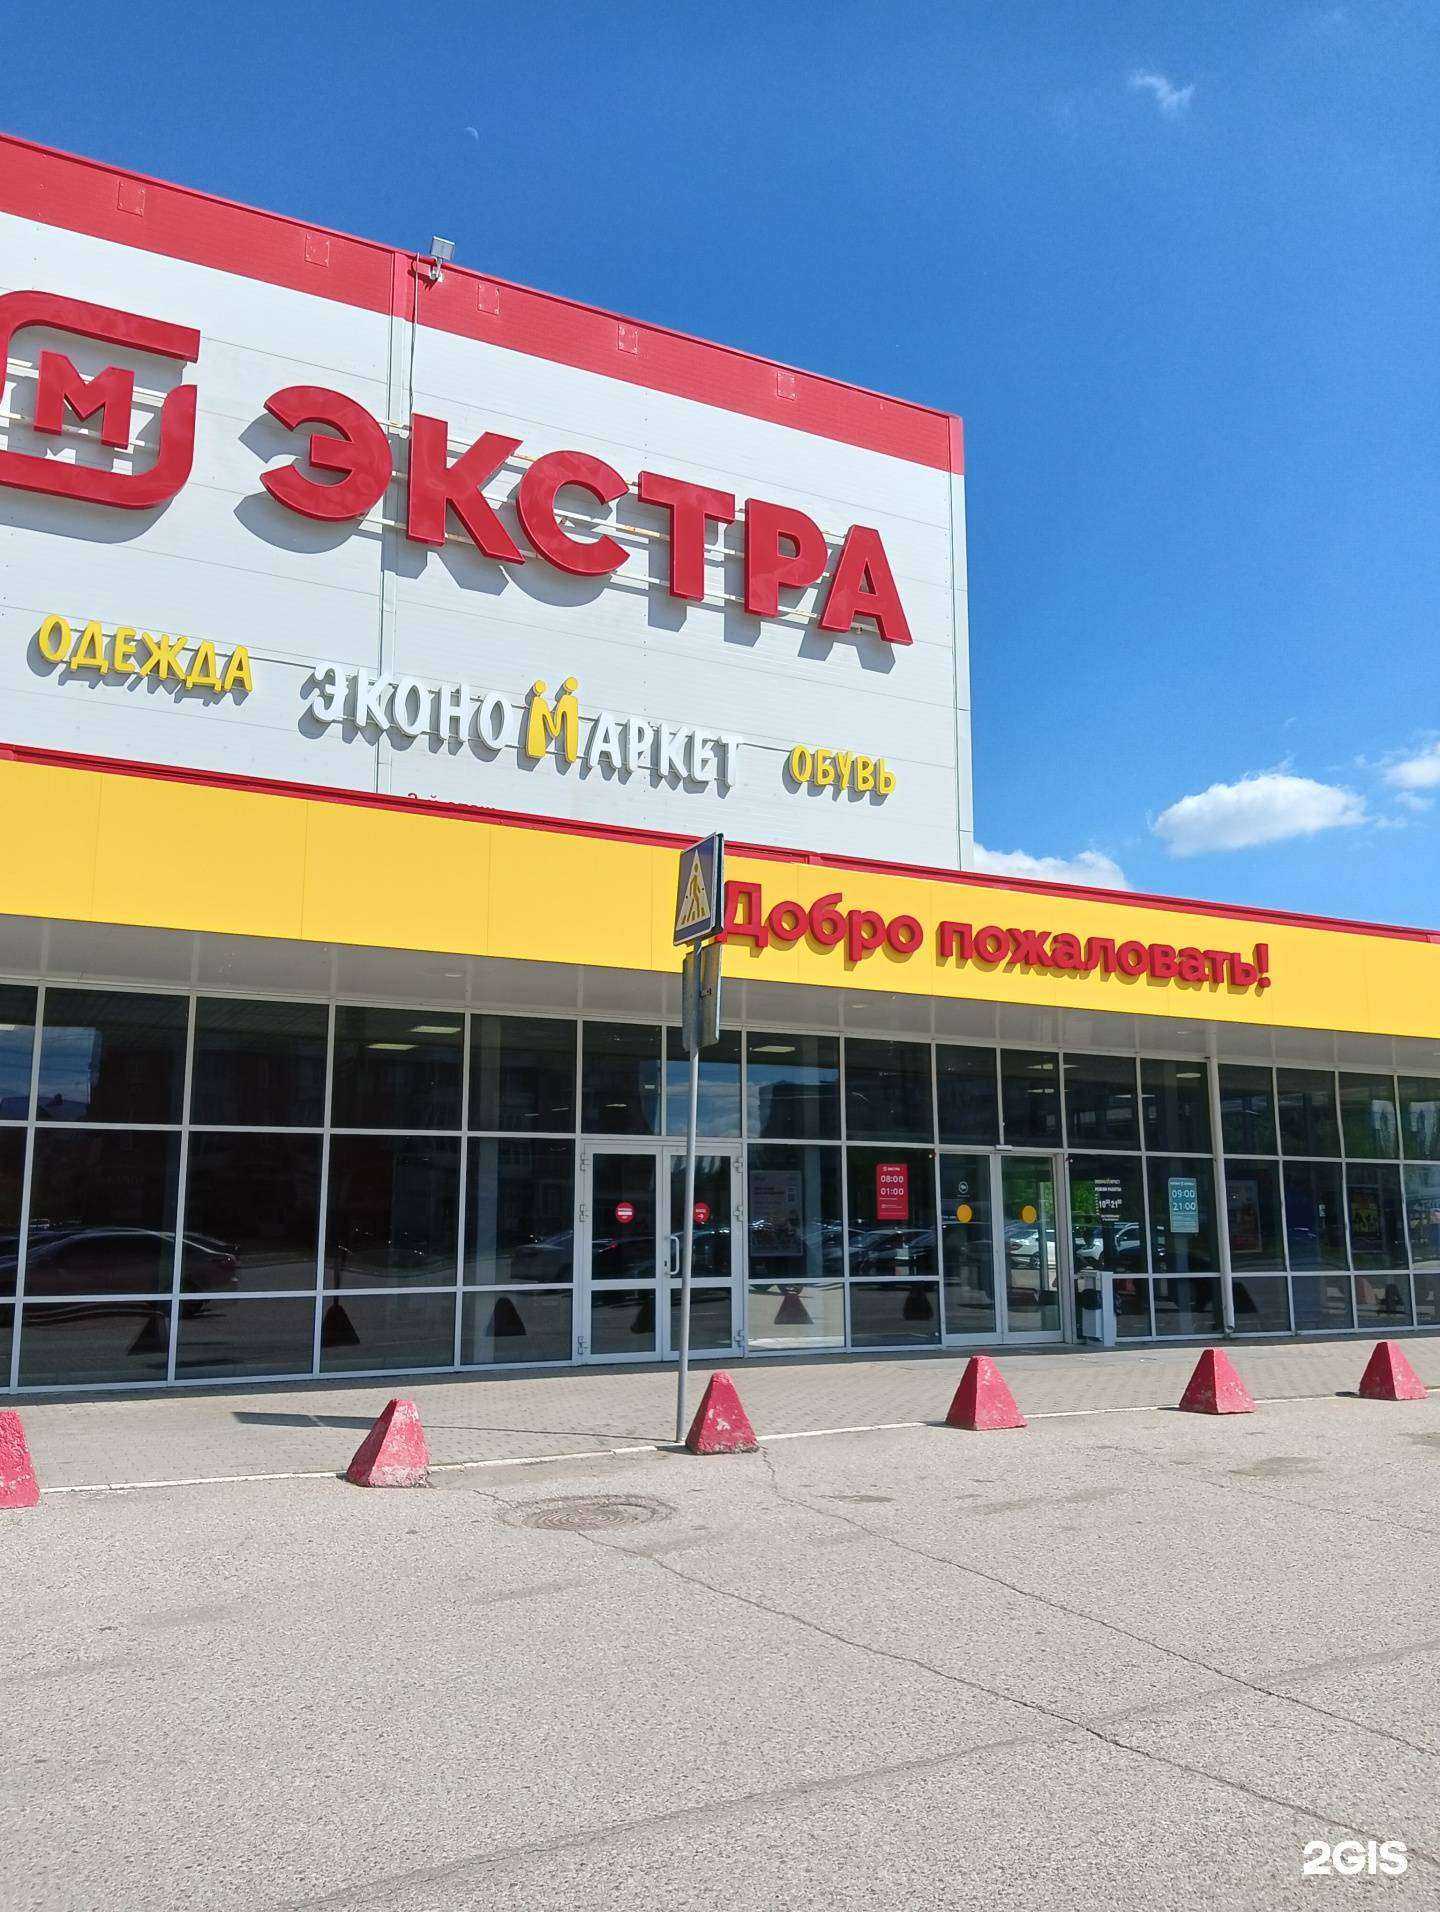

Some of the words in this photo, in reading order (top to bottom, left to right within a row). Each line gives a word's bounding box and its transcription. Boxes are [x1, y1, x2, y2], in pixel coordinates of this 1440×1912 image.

[34, 350, 134, 450] М
[259, 385, 913, 646] ЭКСТРА
[38, 613, 254, 694] ОДЕЖДА
[312, 660, 744, 790] ЭКОНОМАРКЕТ
[789, 744, 897, 796] ОБУВЬ
[714, 880, 924, 962] Добро
[937, 919, 1271, 988] пожаловать!
